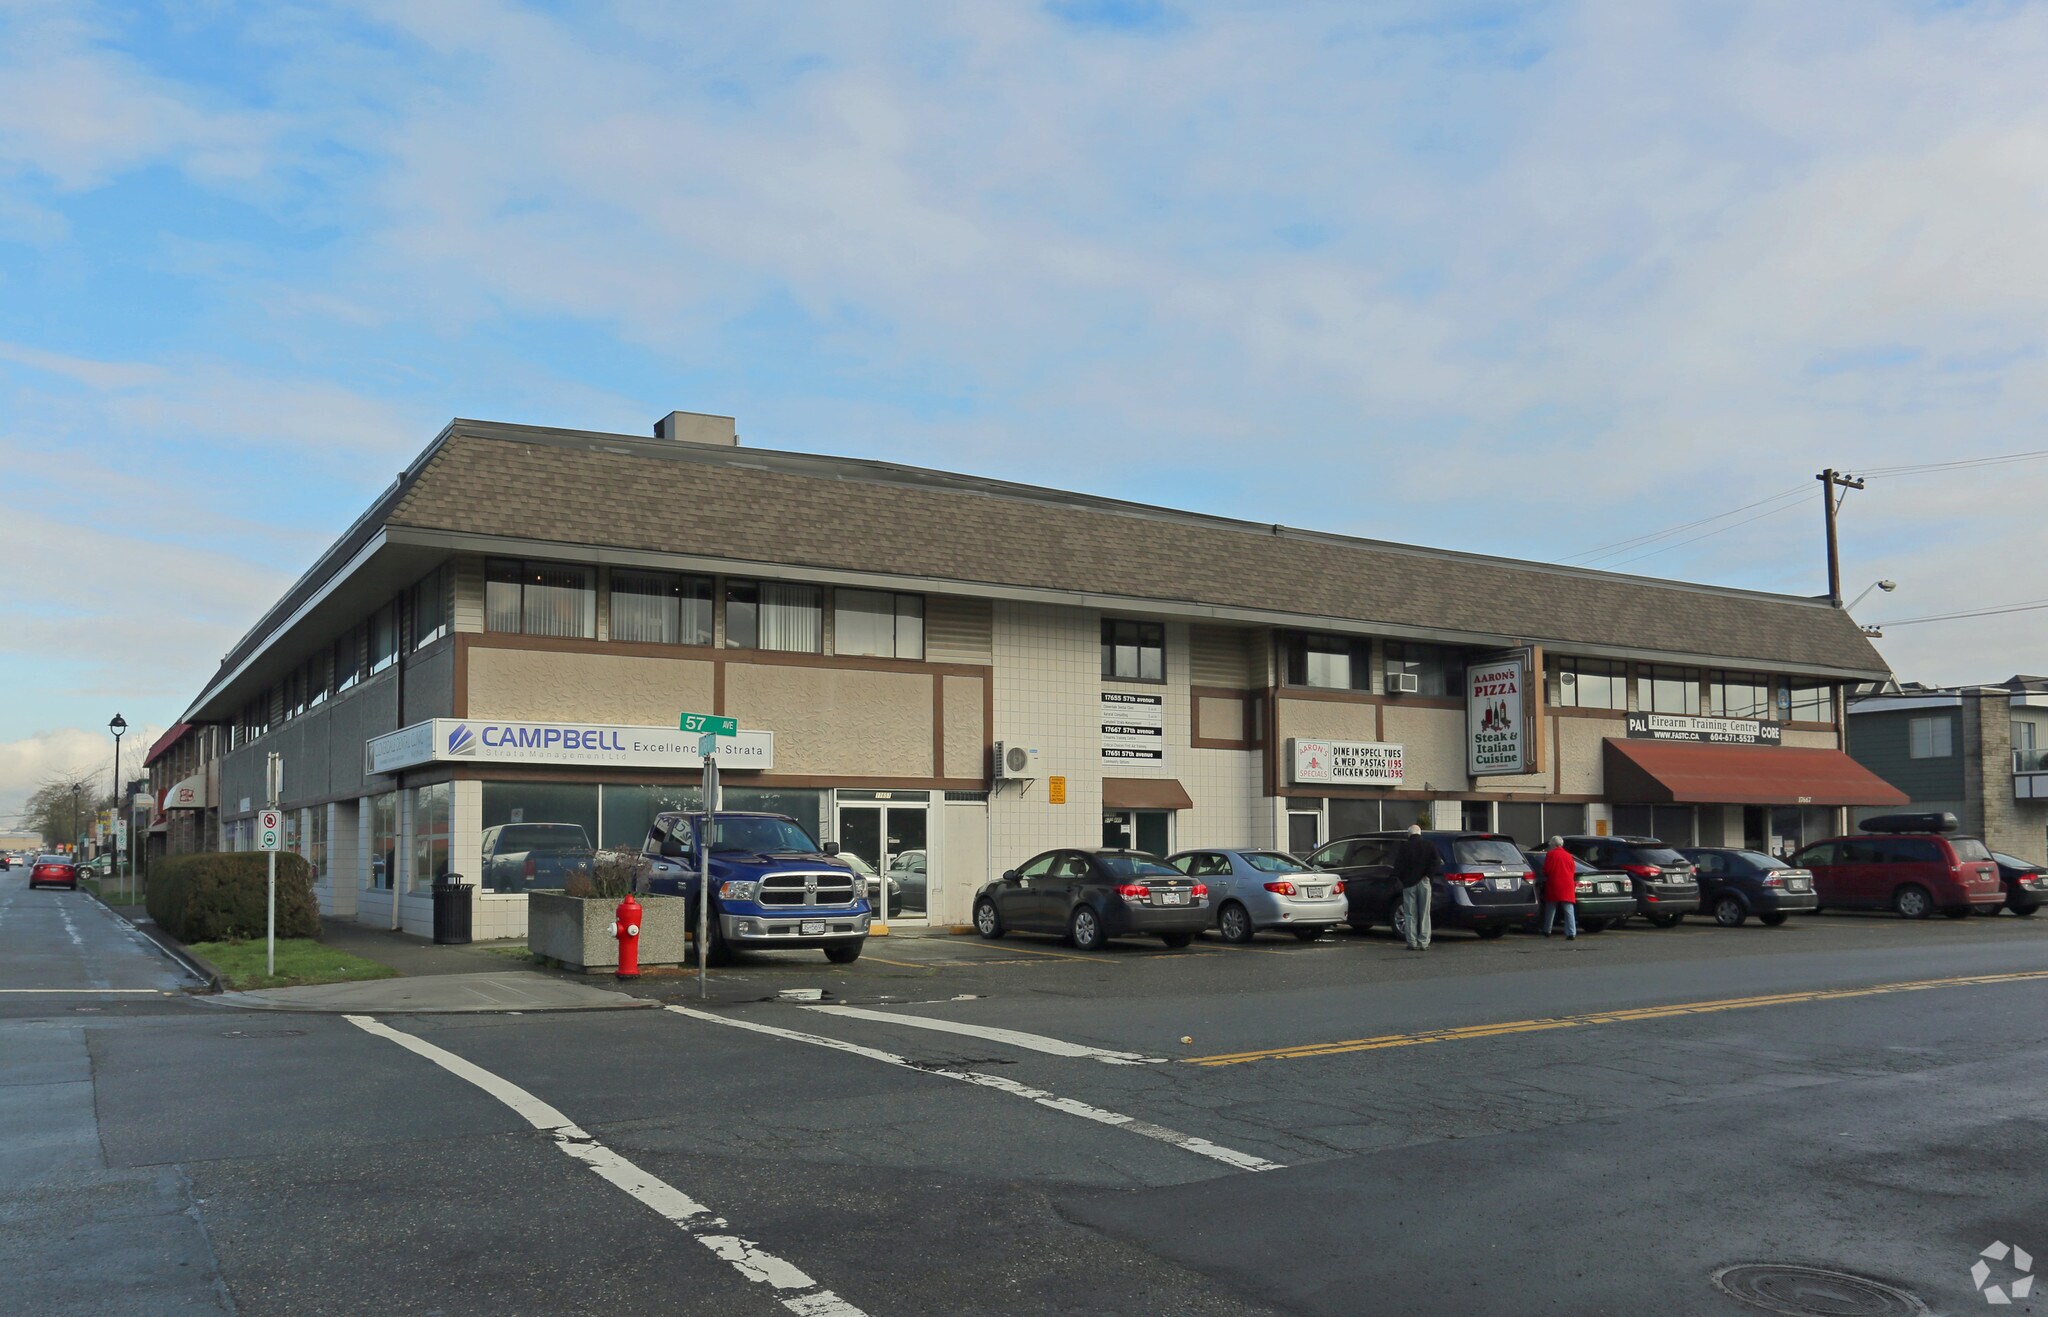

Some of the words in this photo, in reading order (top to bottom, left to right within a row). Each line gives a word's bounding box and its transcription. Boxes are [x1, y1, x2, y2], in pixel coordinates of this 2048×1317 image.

[1474, 669, 1515, 683] AARON'S
[1474, 682, 1517, 697] PIZZA
[685, 715, 706, 731] 57
[722, 721, 733, 729] AVE
[1629, 718, 1647, 731] PAL
[1651, 716, 1687, 728] Firearm
[1691, 718, 1727, 732] Training
[1730, 720, 1757, 732] Centre
[482, 727, 625, 751] CAMPBELL
[1475, 732, 1507, 743] Steak
[1510, 732, 1518, 740] &
[1710, 733, 1755, 743] 604-671-5523
[1761, 726, 1779, 739] CORE
[634, 742, 697, 753] Excellenc
[725, 745, 763, 755] Strata
[1300, 744, 1328, 757] AARON'S
[1333, 747, 1350, 756] DINE
[1352, 748, 1360, 756] IN
[1360, 748, 1382, 757] SPECL
[1384, 749, 1401, 758] TUES
[1477, 742, 1515, 753] Italian
[486, 749, 524, 757] Strata
[529, 750, 605, 760] Management
[1476, 753, 1518, 764] Cuisine
[1334, 757, 1339, 766] &
[1342, 758, 1356, 766] WED
[1360, 759, 1386, 767] PASTAS
[1333, 767, 1364, 777] CHICKEN
